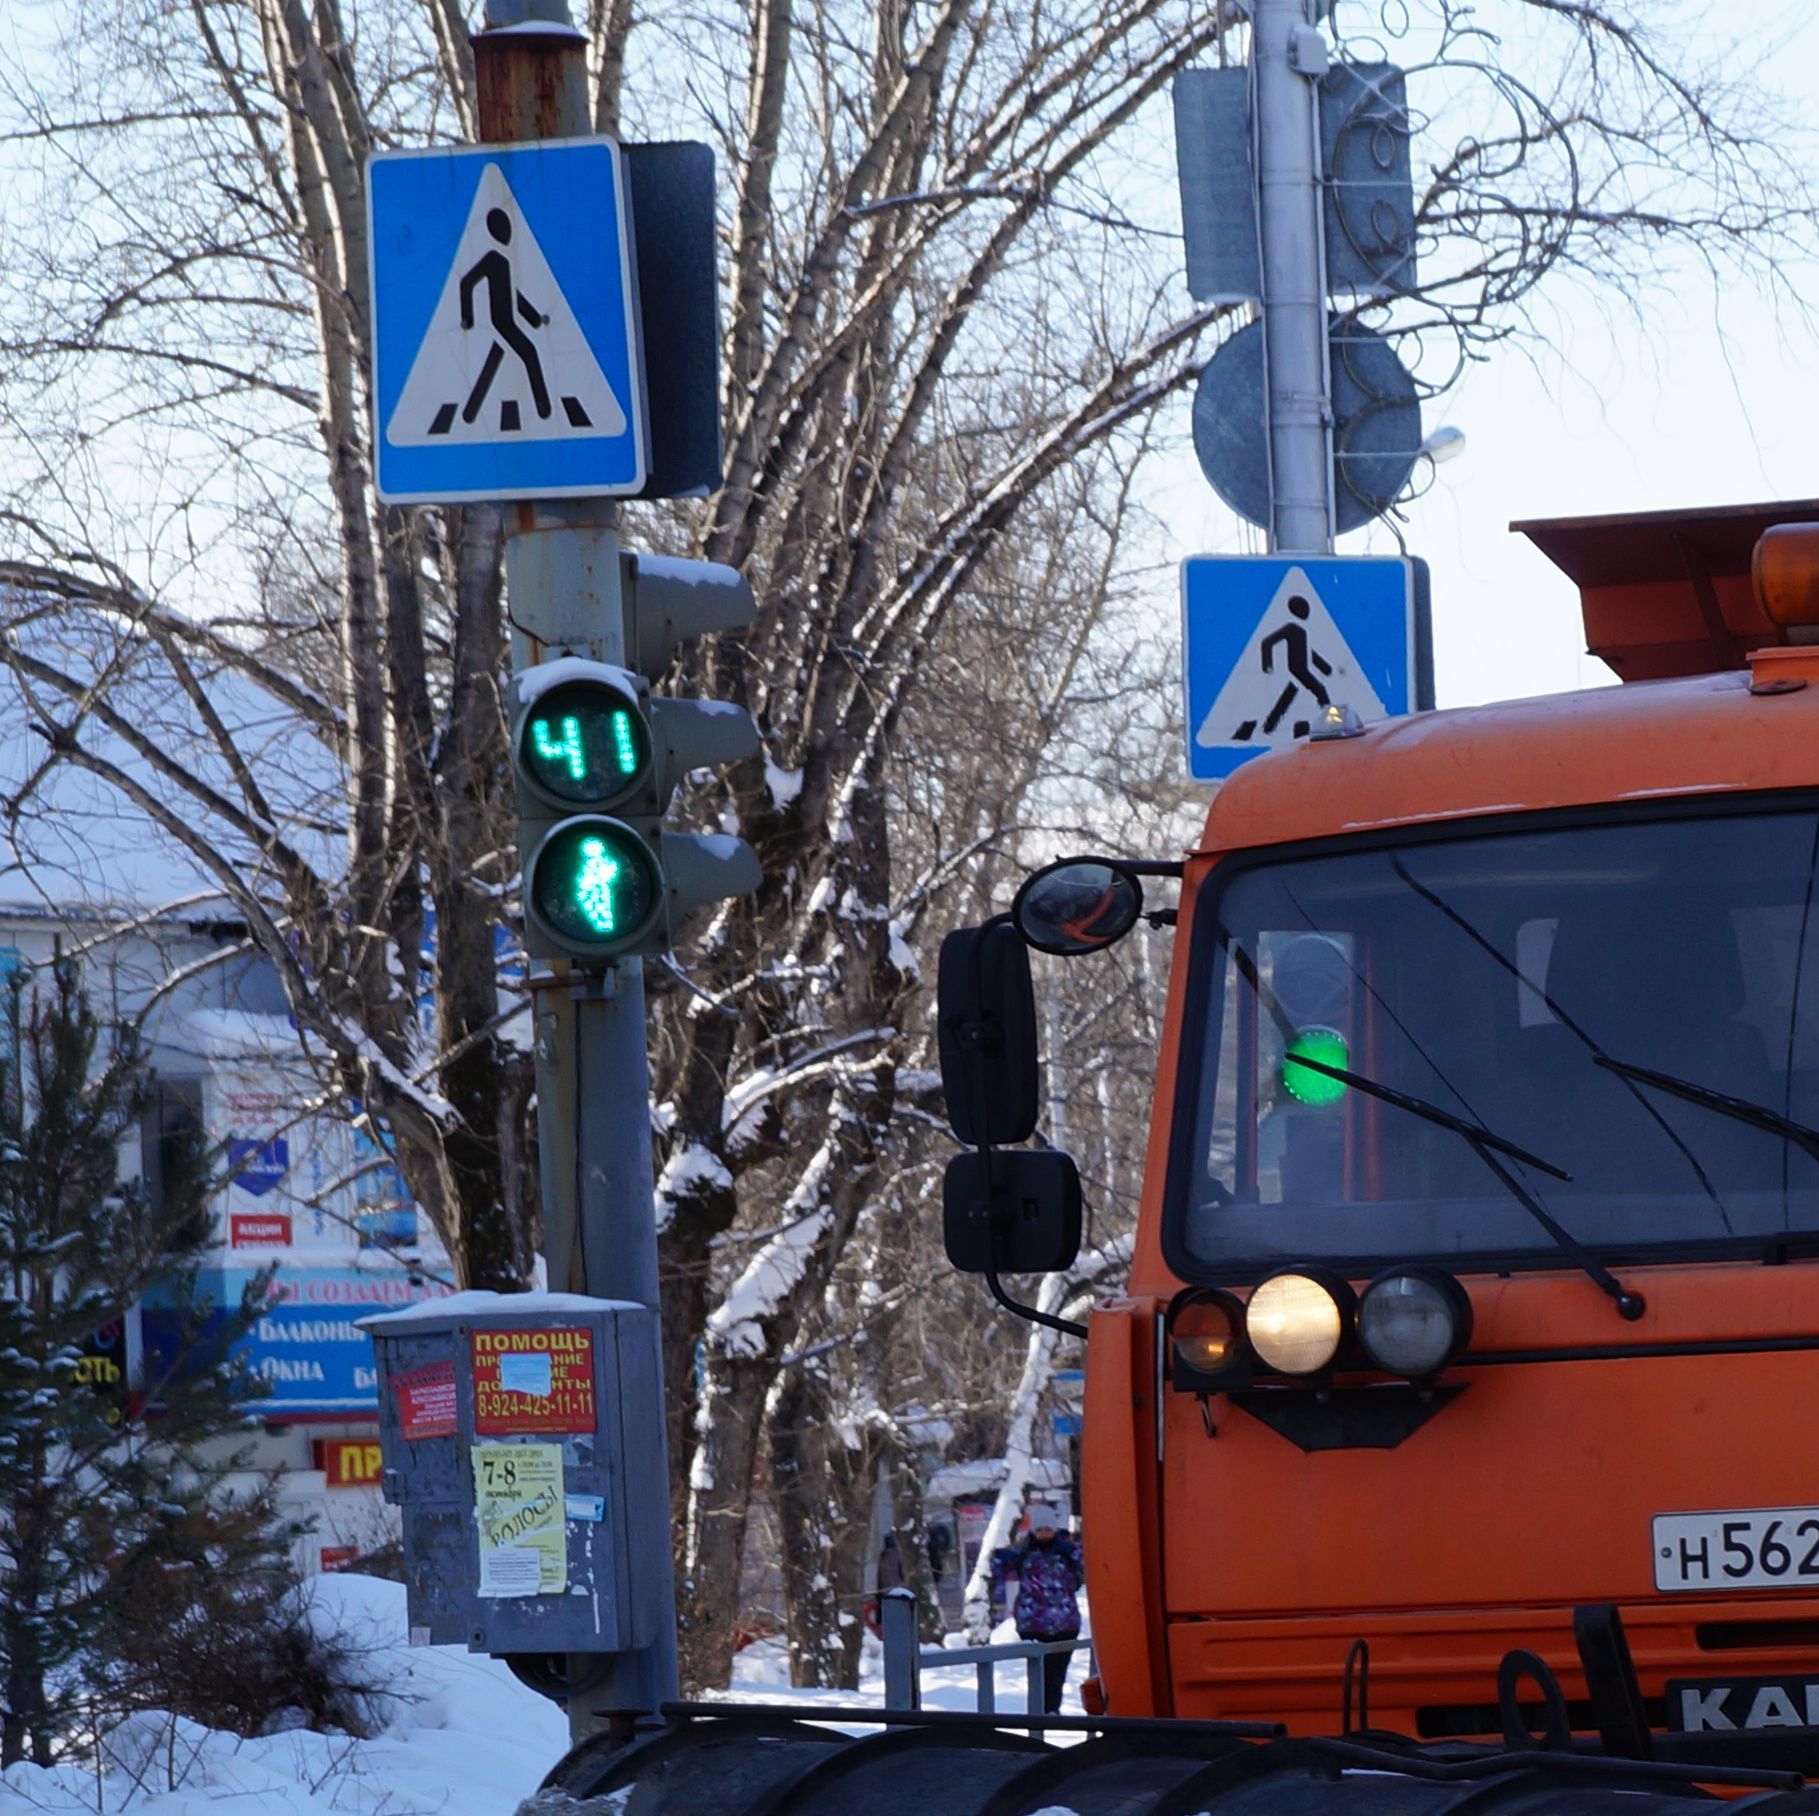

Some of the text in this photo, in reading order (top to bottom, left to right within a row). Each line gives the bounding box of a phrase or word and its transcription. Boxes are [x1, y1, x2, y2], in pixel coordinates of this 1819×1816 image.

[532, 710, 638, 781] 41
[475, 1332, 590, 1351] ПОМОЩЬ
[478, 1392, 593, 1417] 8-924-425-11-11
[340, 1445, 383, 1482] ПР
[483, 1460, 516, 1486] 7-8
